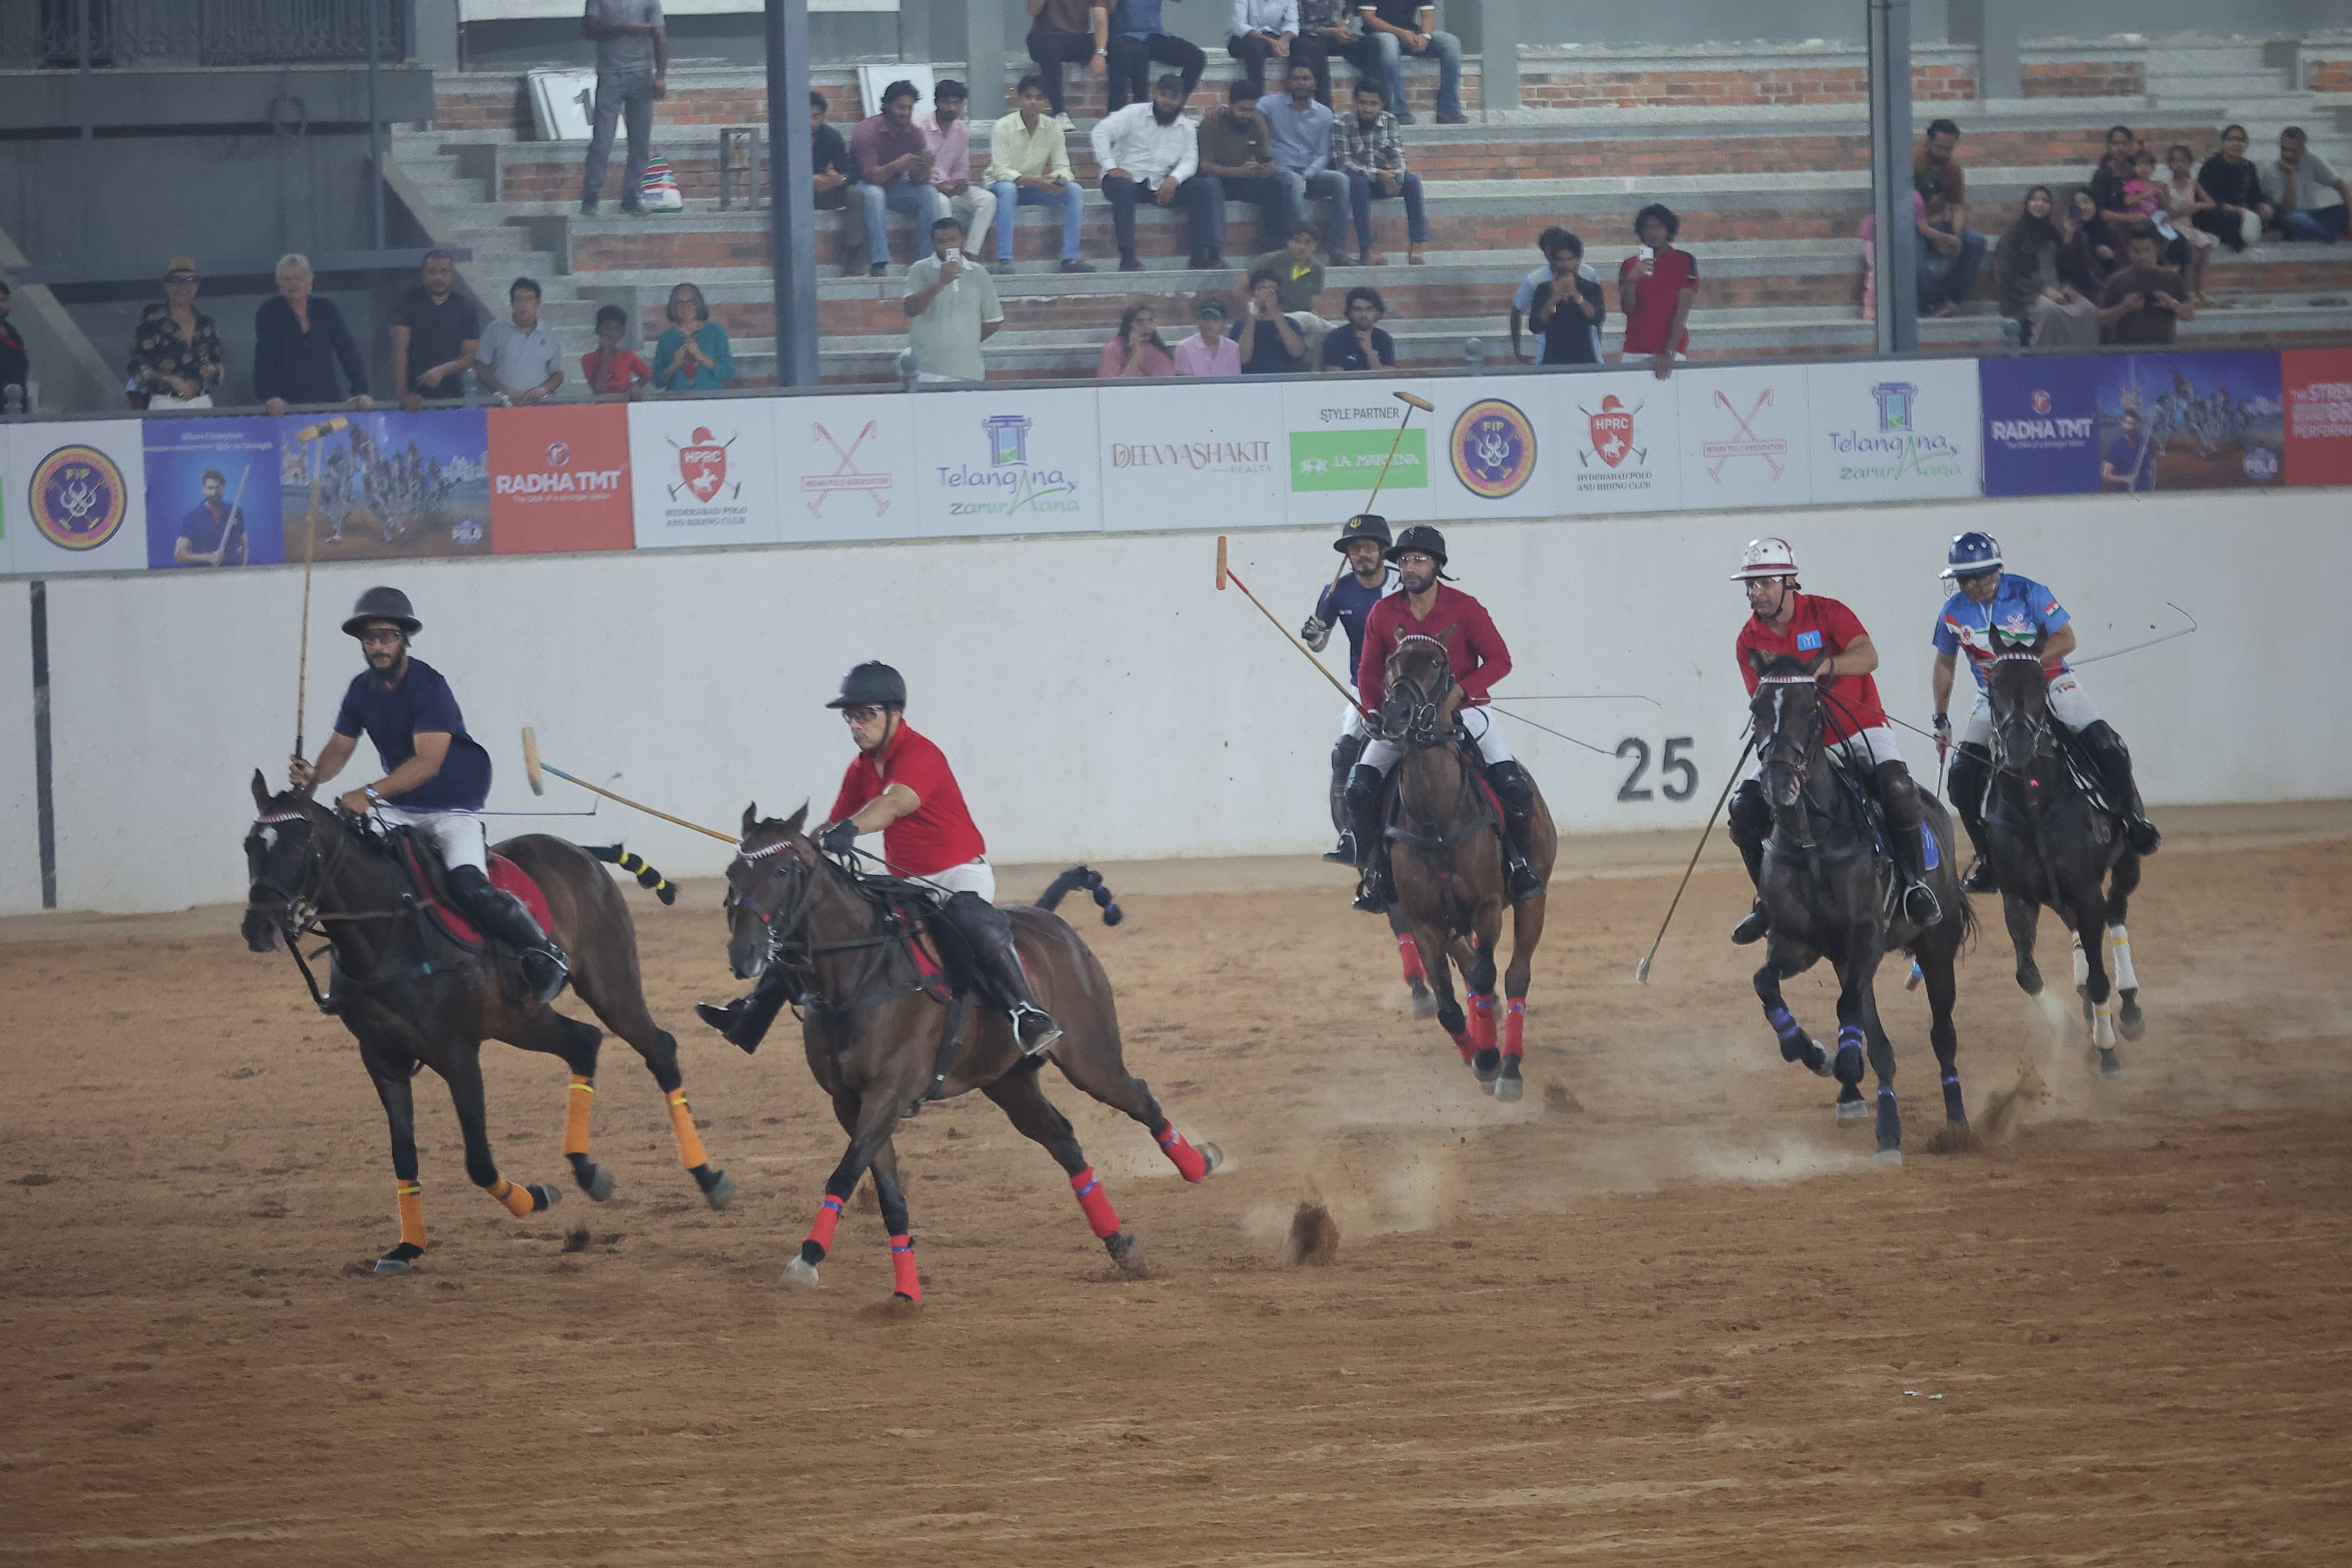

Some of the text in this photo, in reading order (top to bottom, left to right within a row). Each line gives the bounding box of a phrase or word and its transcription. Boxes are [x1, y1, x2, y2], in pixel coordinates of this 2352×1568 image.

[1321, 407, 1400, 421] STYLE PARTNER
[1482, 421, 1505, 432] FIP
[1596, 418, 1629, 430] HPRC
[1992, 417, 2094, 440] RADHA TMT
[496, 470, 622, 494] RADHA TMT
[1615, 737, 1700, 803] 25
